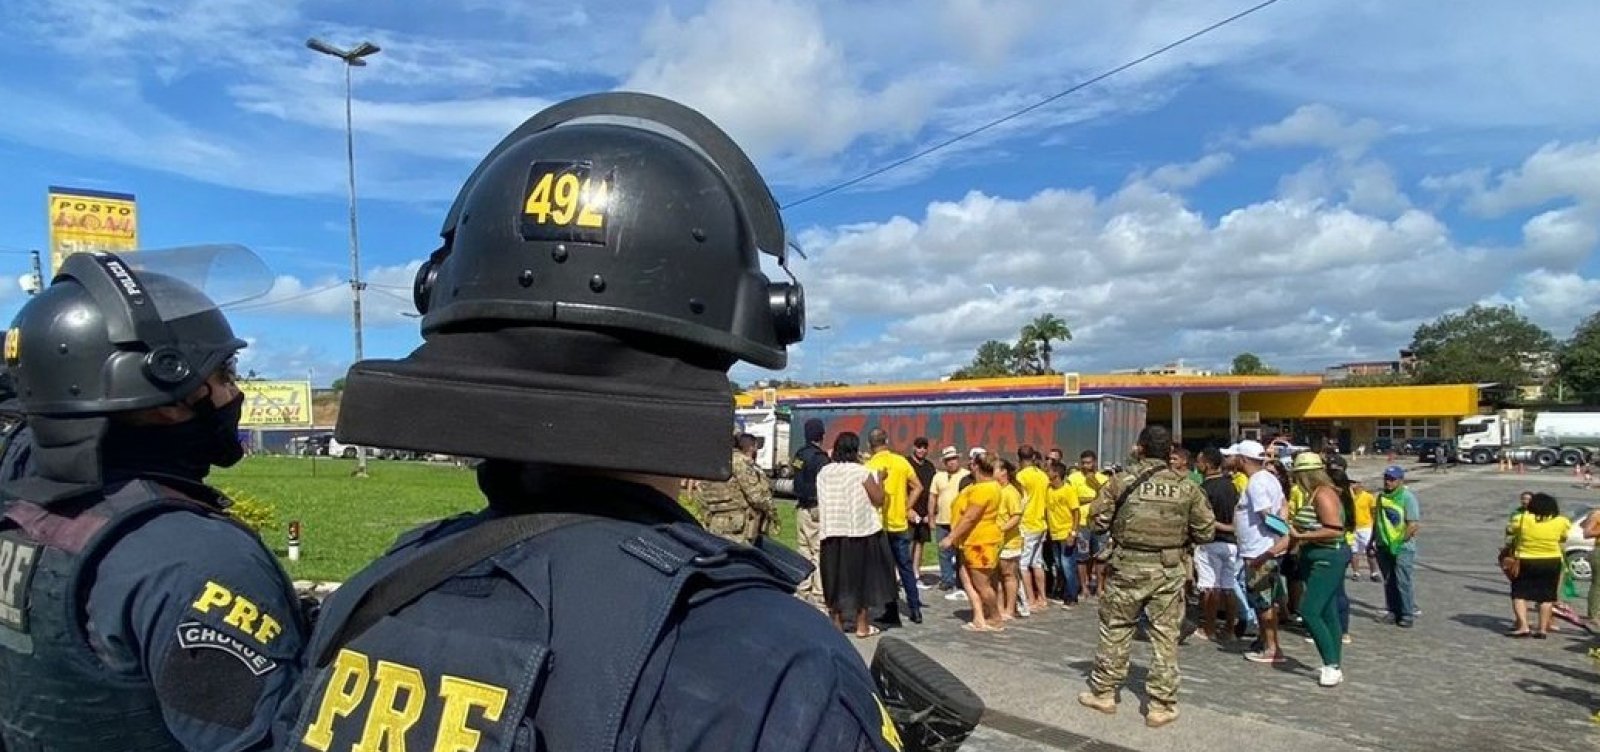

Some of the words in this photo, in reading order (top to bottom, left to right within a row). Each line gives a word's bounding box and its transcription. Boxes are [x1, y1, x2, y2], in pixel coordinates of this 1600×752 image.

[60, 201, 131, 216] POSTO
[525, 173, 608, 228] 492
[1142, 482, 1179, 498] PRF
[192, 581, 282, 645] PRF
[302, 648, 508, 752] PRF
